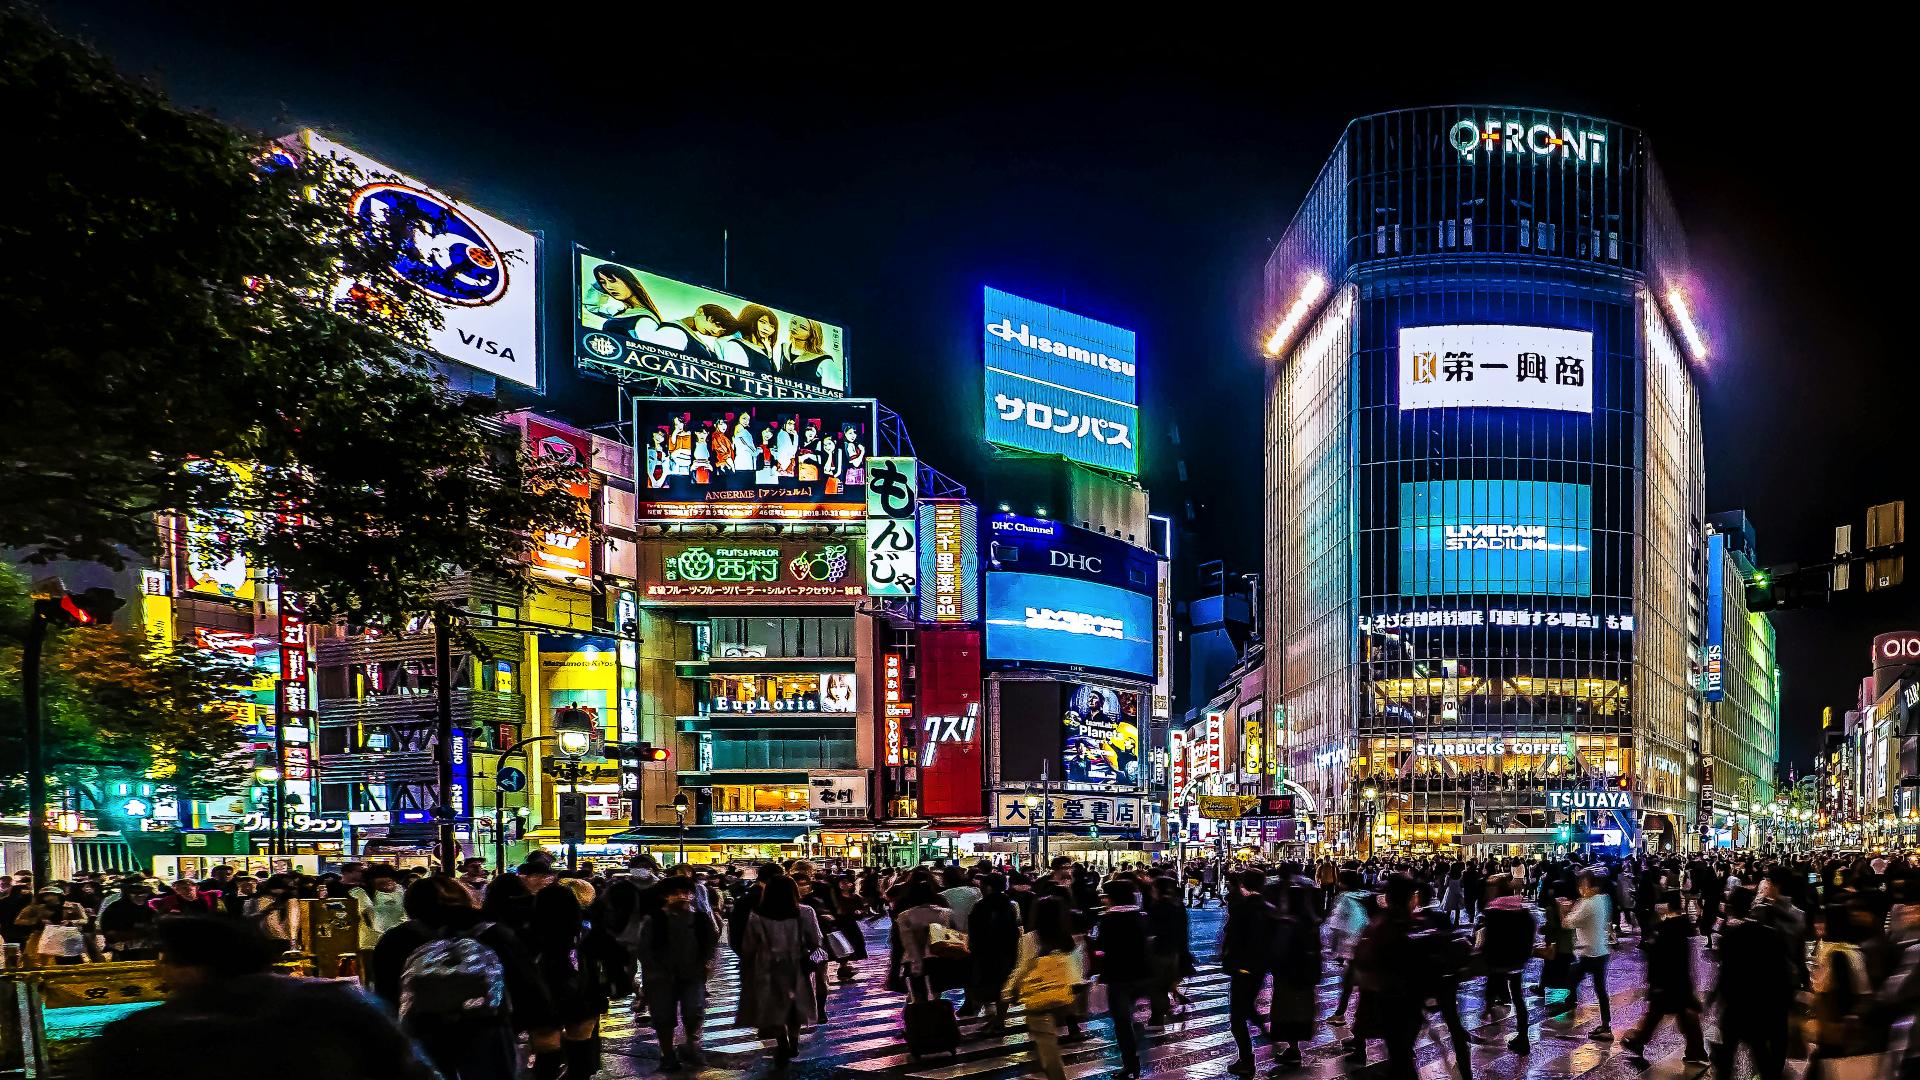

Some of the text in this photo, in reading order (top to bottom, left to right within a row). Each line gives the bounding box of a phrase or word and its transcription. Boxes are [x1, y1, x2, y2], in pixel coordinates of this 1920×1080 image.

[456, 328, 517, 363] VISA
[986, 318, 1135, 377] Hisamitsu
[625, 340, 657, 353] BRAND
[657, 348, 679, 358] NEW
[680, 353, 700, 364] IDOL
[700, 358, 734, 372] SOCIETY
[805, 384, 844, 399] RELEASE
[1442, 351, 1585, 388] 第一興商
[994, 392, 1132, 449] サロンパス
[705, 490, 755, 500] ANGERME
[868, 458, 917, 594] もんじゃ
[992, 520, 1054, 536] DHC Channel
[666, 557, 677, 581] 渋谷
[716, 558, 779, 582] 西村
[935, 507, 957, 615] 三千里薬品
[1050, 550, 1102, 573] DHC
[715, 696, 817, 713] Euphoria
[1416, 743, 1569, 757] STARBUCKS COFFEE
[1549, 792, 1631, 809] TSUTAYA
[243, 811, 344, 833] グルタウン
